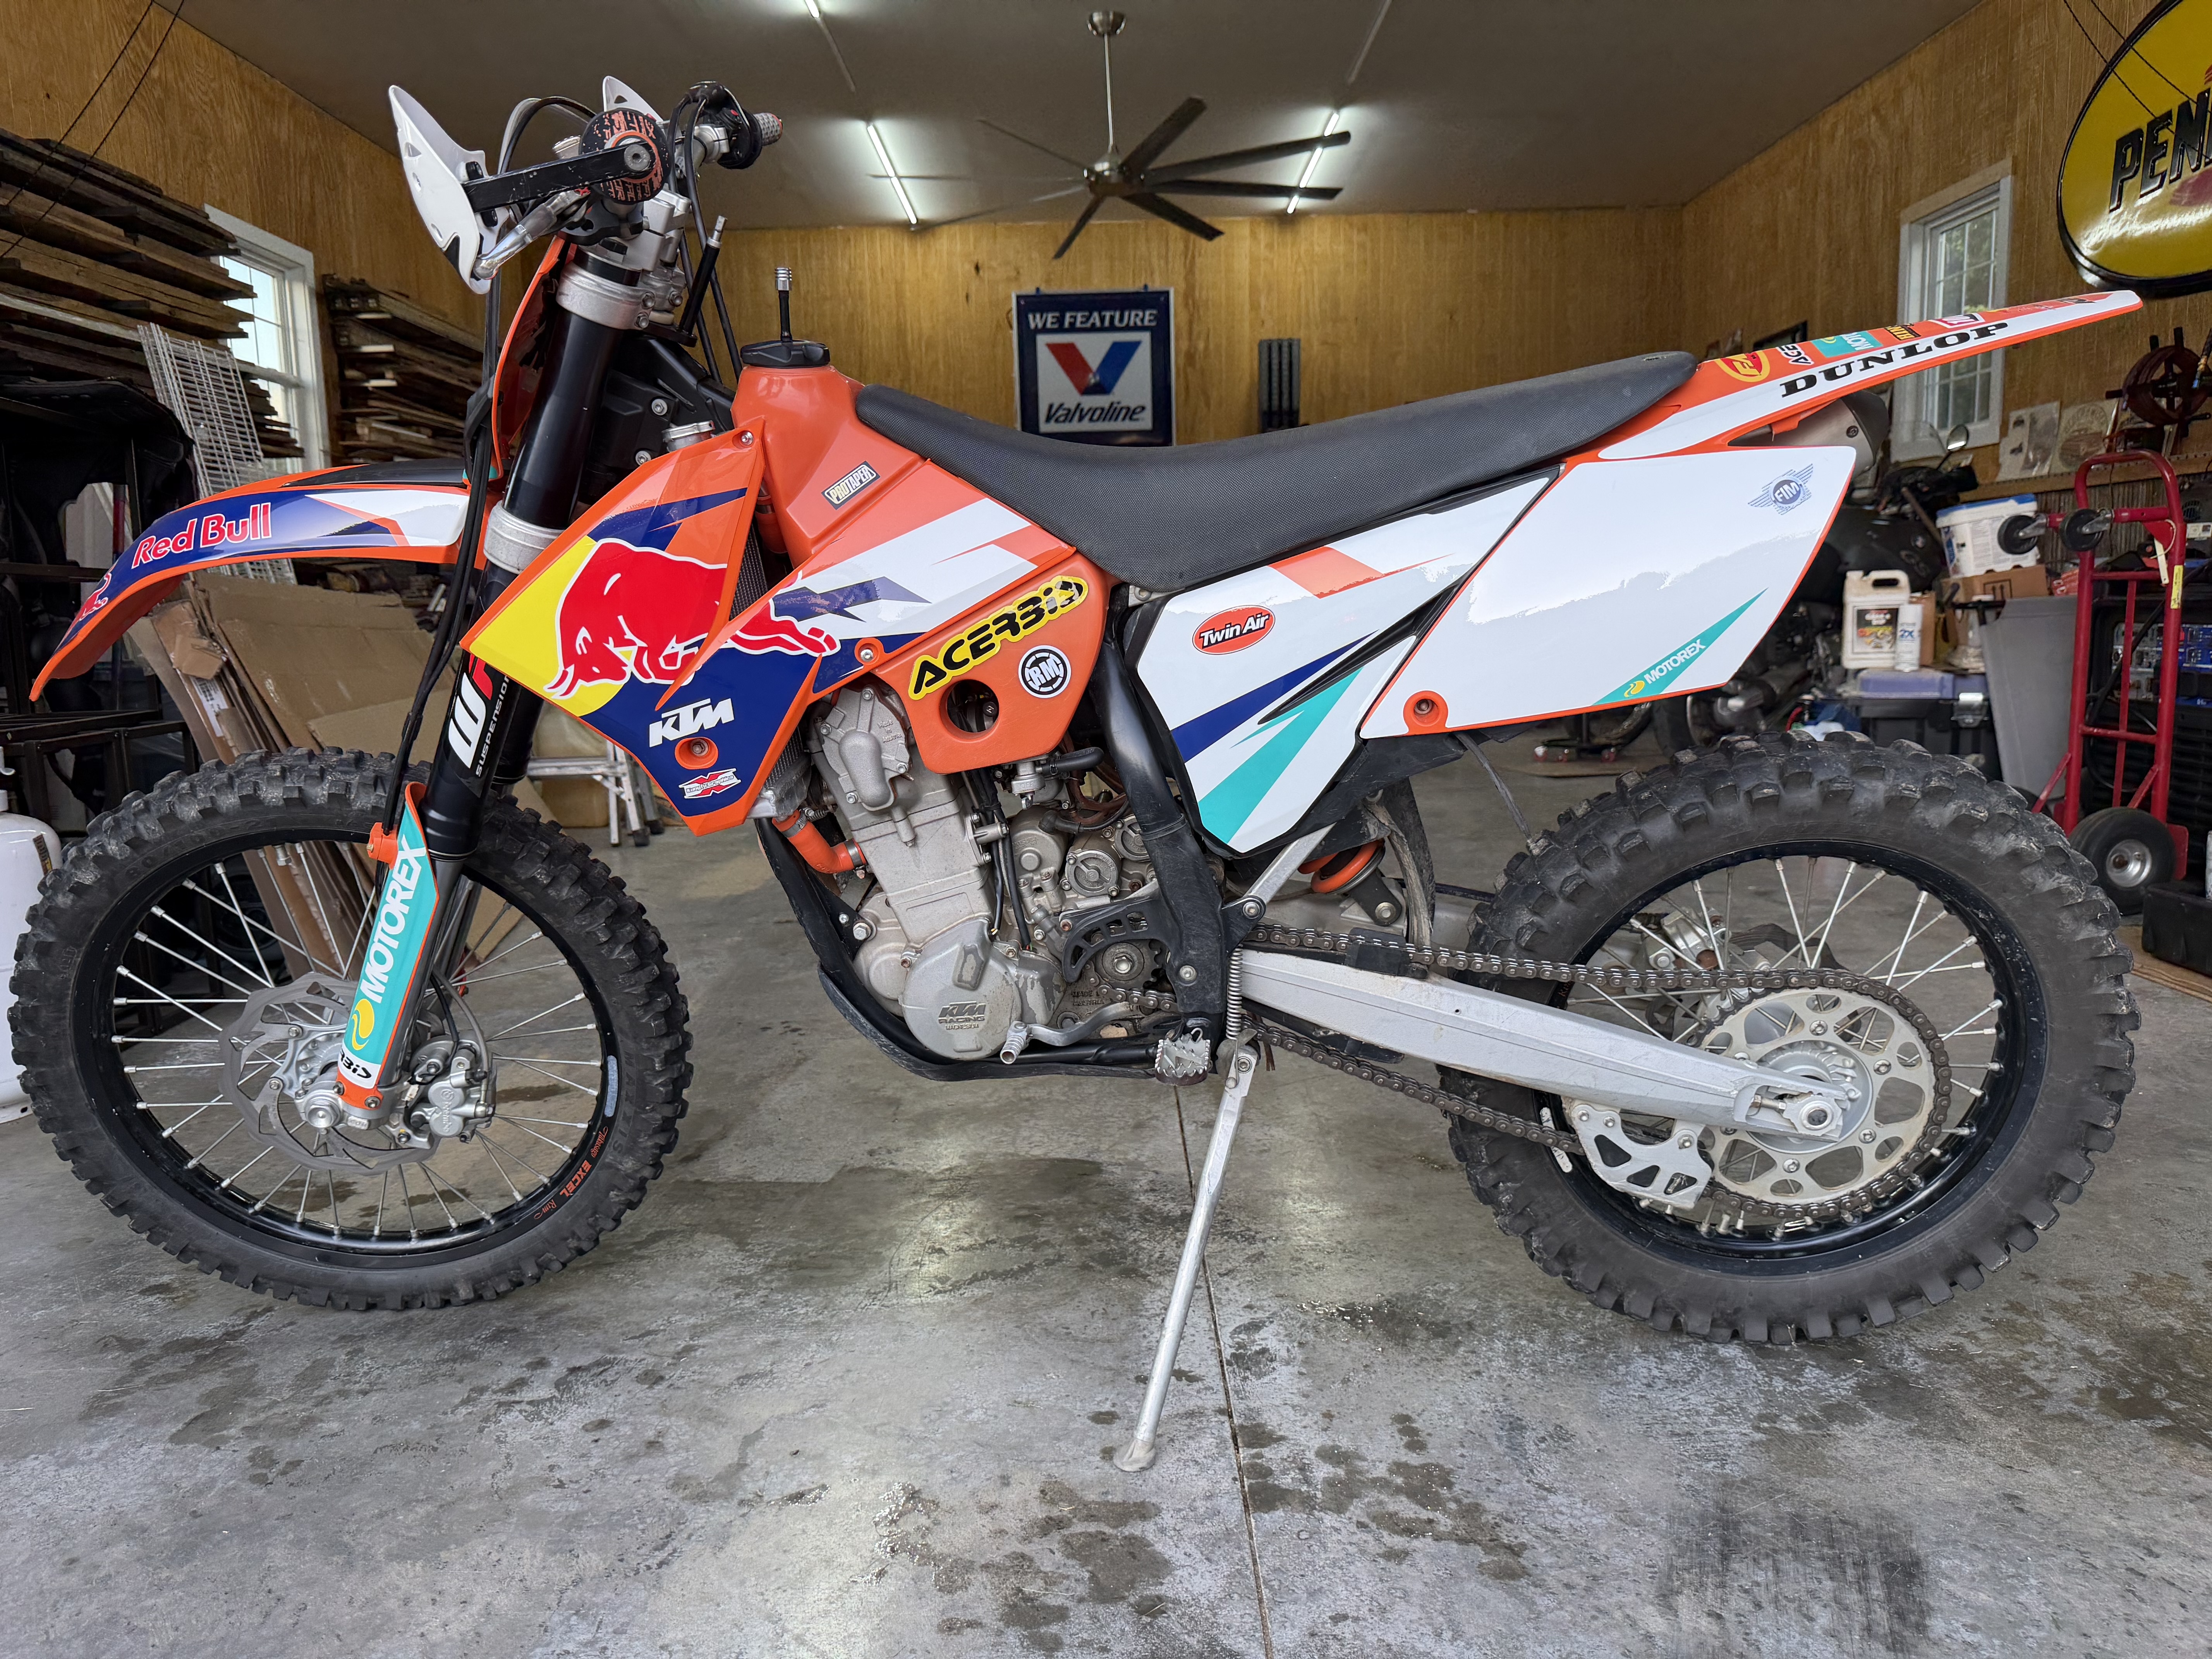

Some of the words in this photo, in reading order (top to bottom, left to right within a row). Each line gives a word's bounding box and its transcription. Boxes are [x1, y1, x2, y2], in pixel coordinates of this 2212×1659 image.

[2109, 87, 2212, 213] PEN
[1027, 312, 1060, 330] WE
[1063, 309, 1158, 328] FEATURE
[1779, 322, 2009, 398] DUNLOP
[1044, 401, 1145, 423] Valvoline
[828, 465, 873, 503] PROTAPER
[1774, 481, 1801, 502] FIM
[131, 518, 198, 569] Red
[200, 502, 272, 548] Bull
[1199, 622, 1242, 649] Twin
[1241, 612, 1270, 637] Air
[1644, 639, 1707, 685] MOTOREX
[649, 698, 735, 748] KTM
[707, 775, 735, 788] Graphics
[359, 833, 426, 1005] MOTOREX
[938, 1001, 986, 1018] KTM
[938, 1015, 985, 1024] RACING
[559, 1159, 592, 1197] EXCEL
